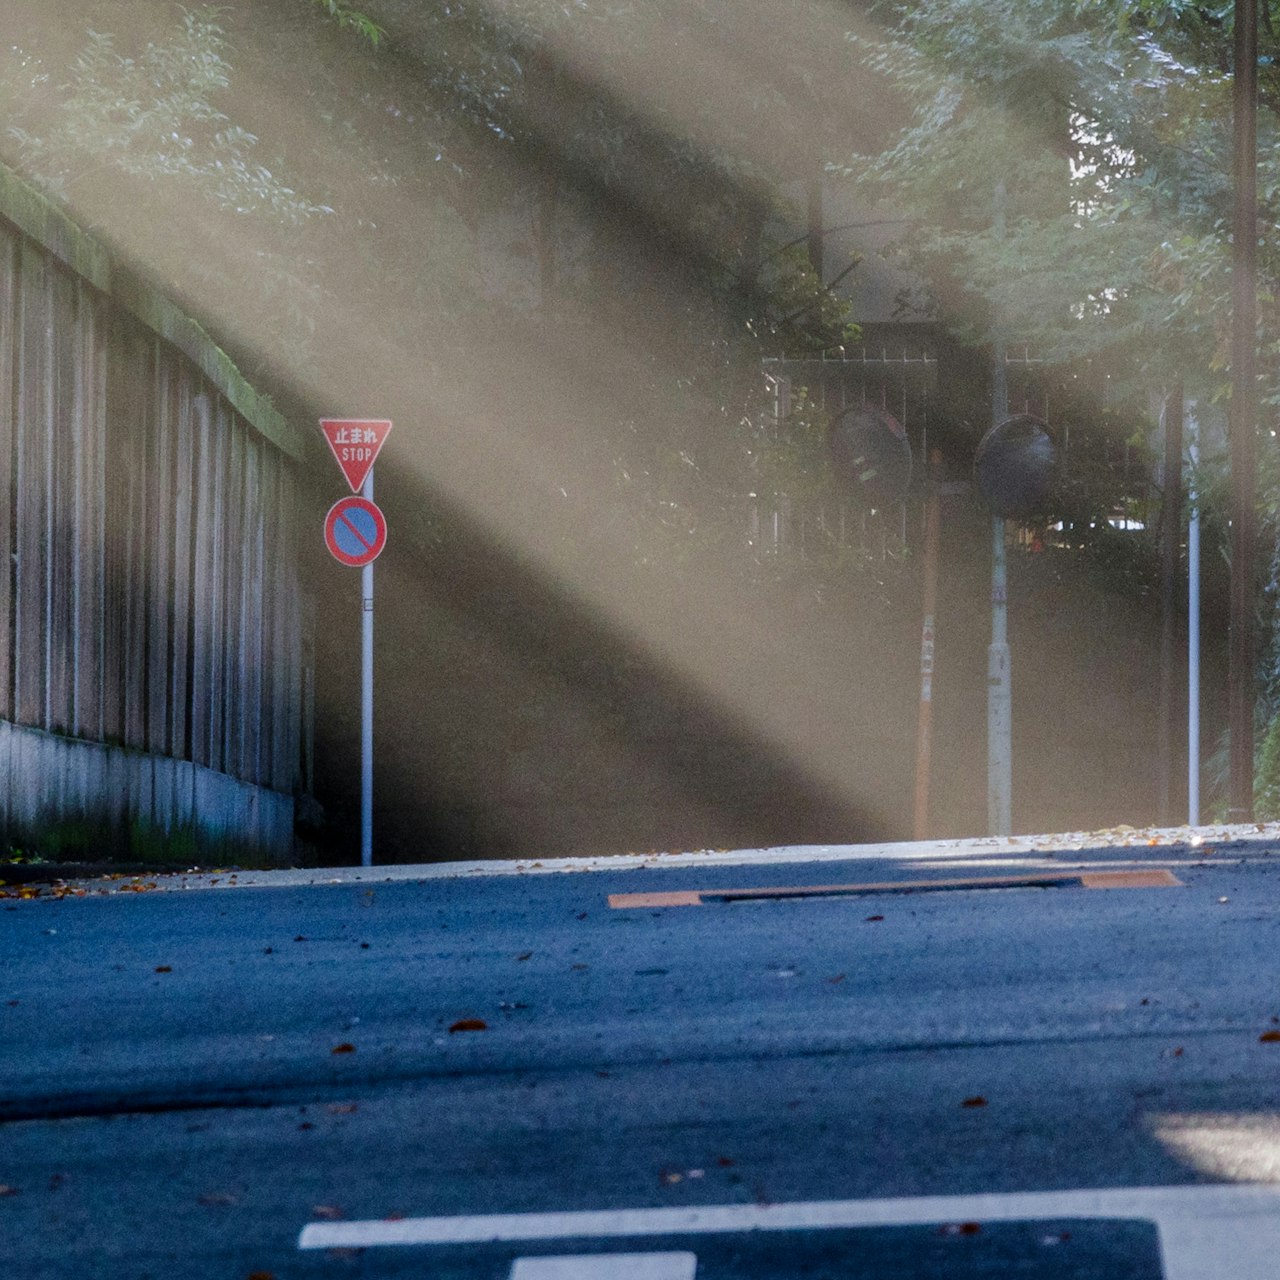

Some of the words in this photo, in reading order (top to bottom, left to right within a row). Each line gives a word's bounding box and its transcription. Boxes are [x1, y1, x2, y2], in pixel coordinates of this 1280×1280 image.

[335, 426, 378, 444] 止まれ
[342, 447, 372, 461] STOP
